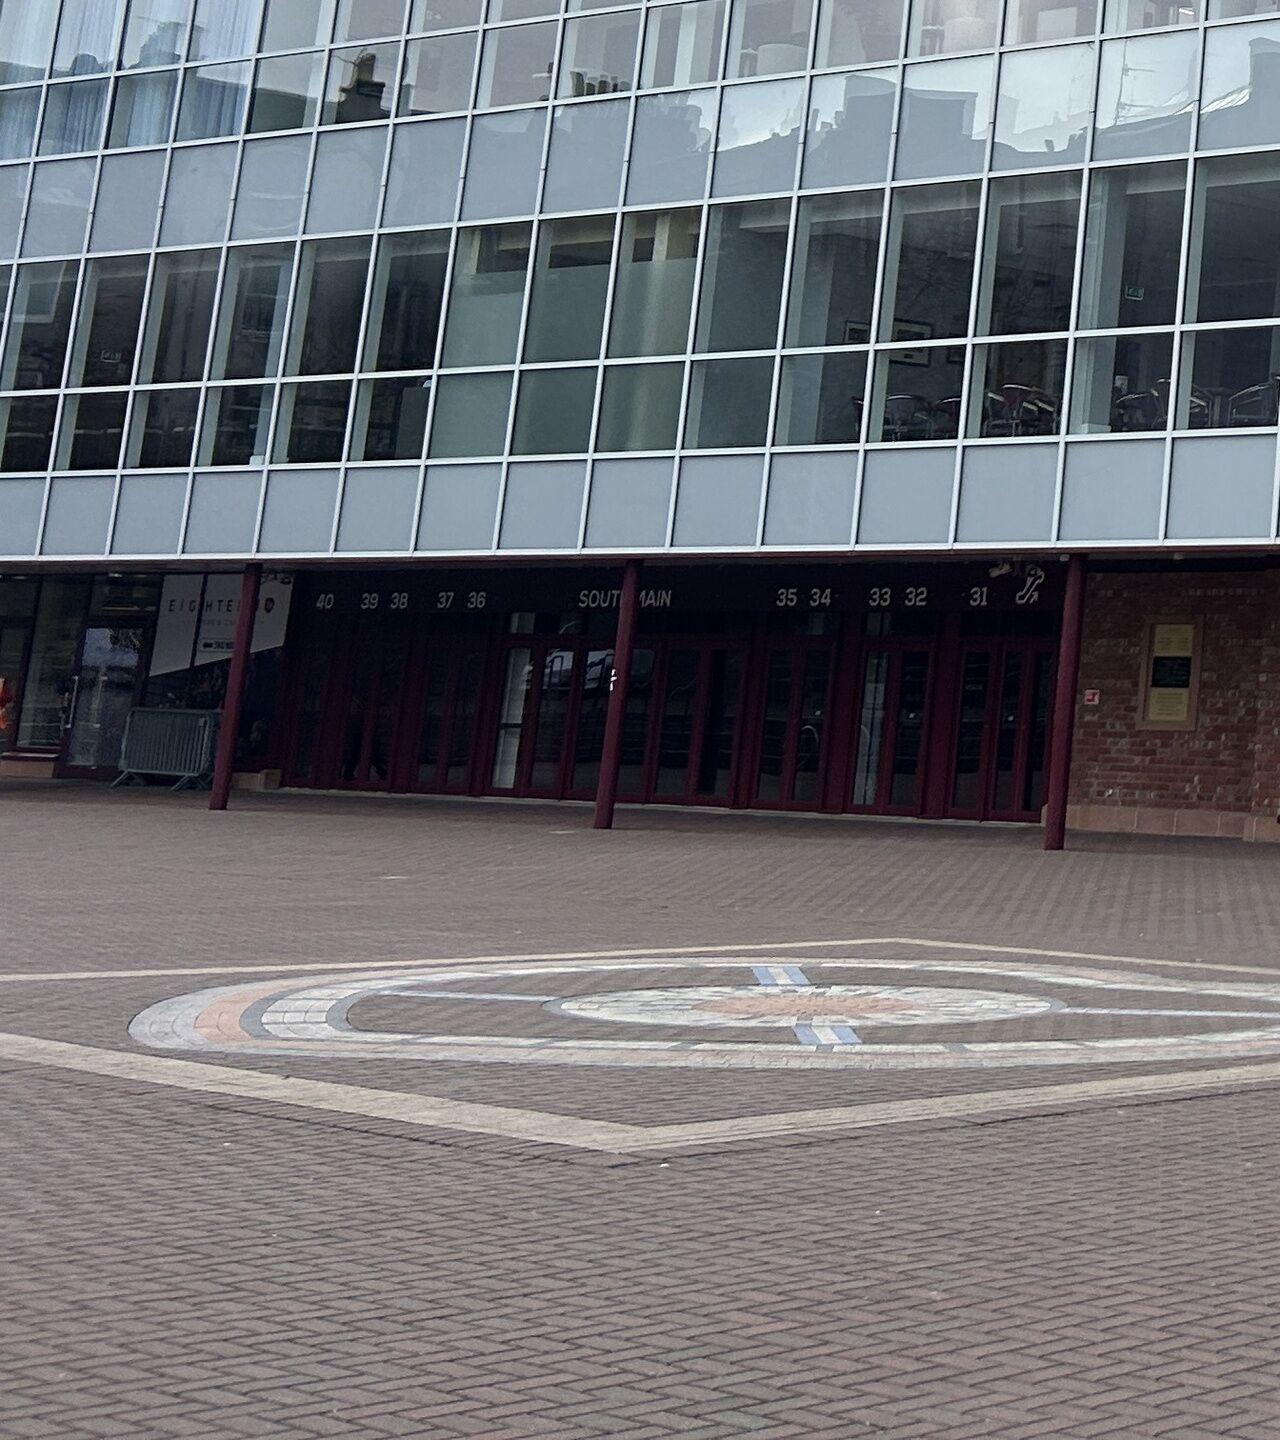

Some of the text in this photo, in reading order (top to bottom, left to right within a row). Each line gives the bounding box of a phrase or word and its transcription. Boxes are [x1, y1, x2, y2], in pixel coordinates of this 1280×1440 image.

[167, 598, 242, 613] EIGHTE
[315, 593, 335, 609] 40
[359, 592, 379, 610] 39
[389, 592, 409, 609] 38
[436, 591, 455, 609] 37
[466, 591, 487, 609] 36
[578, 589, 621, 608] SOUT
[775, 587, 798, 607] 35
[808, 587, 832, 607] 34
[868, 586, 892, 607] 33
[903, 586, 928, 607] 32
[968, 586, 989, 607] 31
